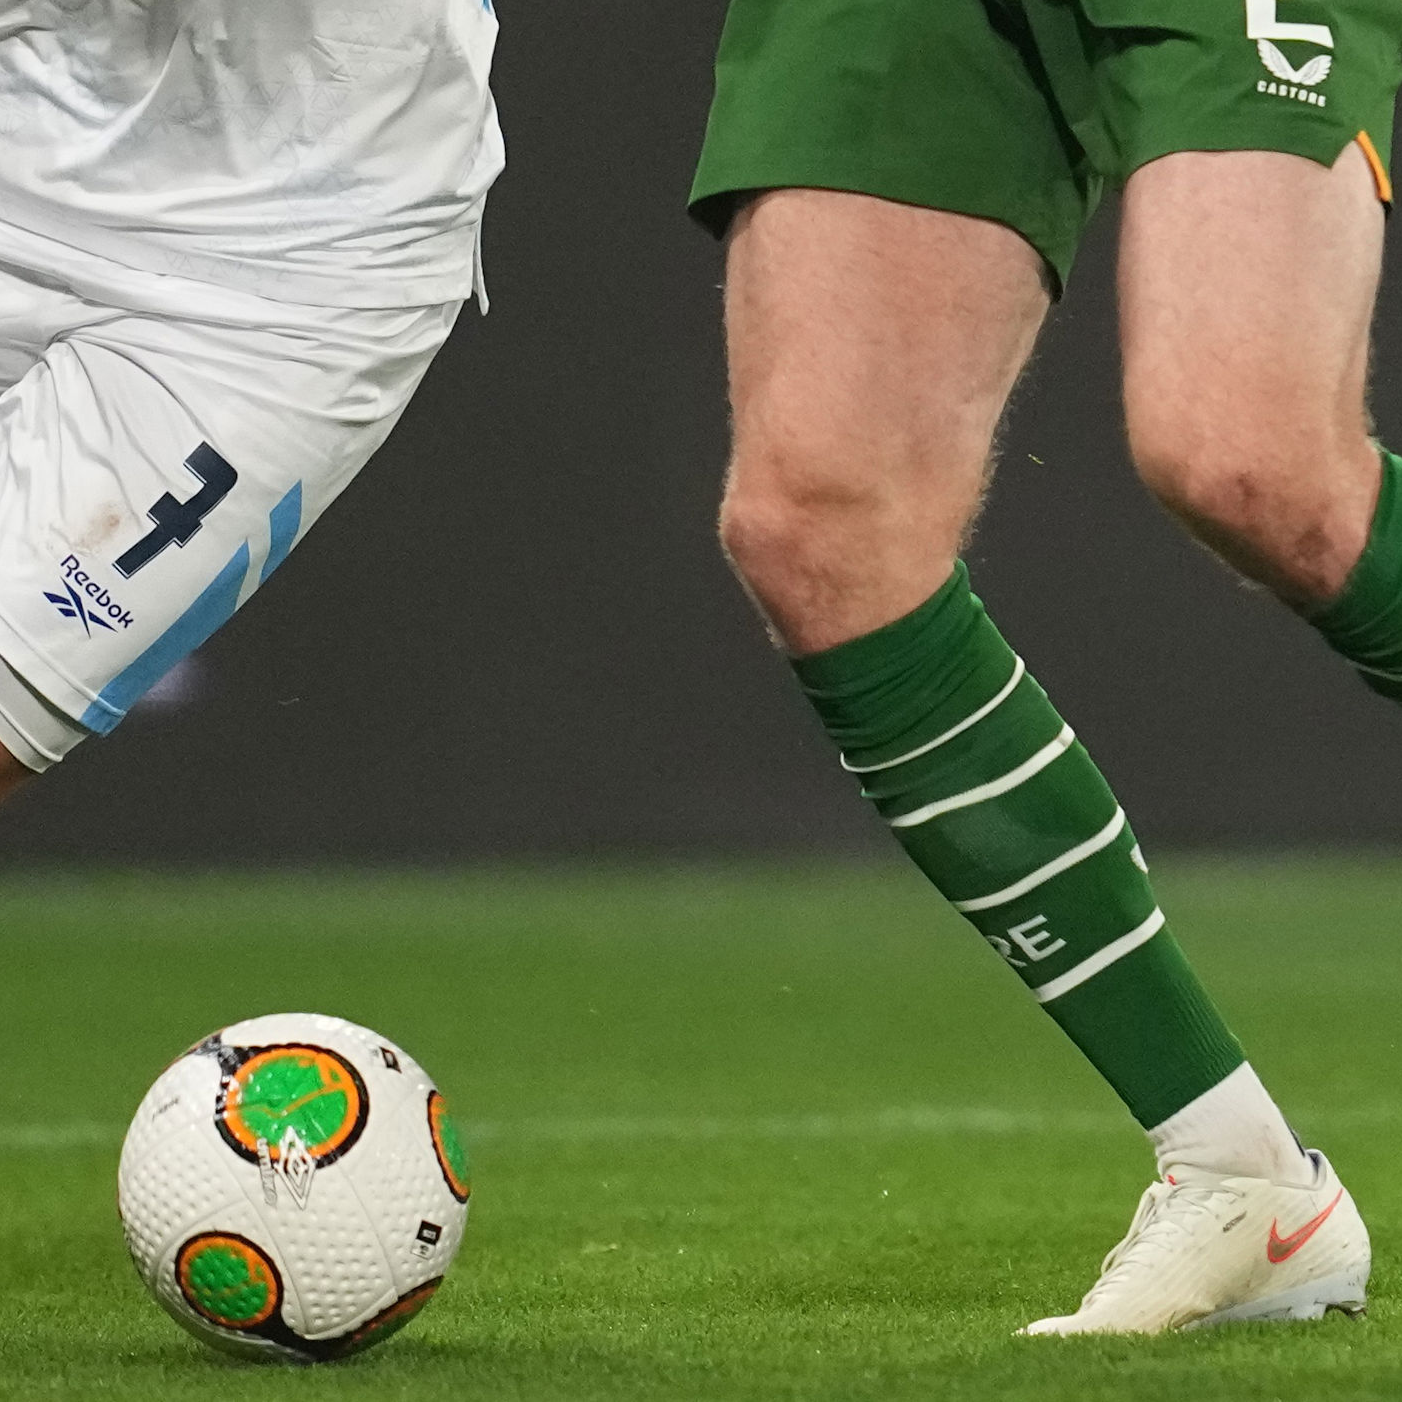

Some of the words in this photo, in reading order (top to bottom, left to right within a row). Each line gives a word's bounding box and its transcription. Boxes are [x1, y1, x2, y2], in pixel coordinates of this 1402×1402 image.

[1256, 79, 1327, 108] CASTORE
[110, 441, 239, 580] 7
[60, 554, 135, 629] Reebok
